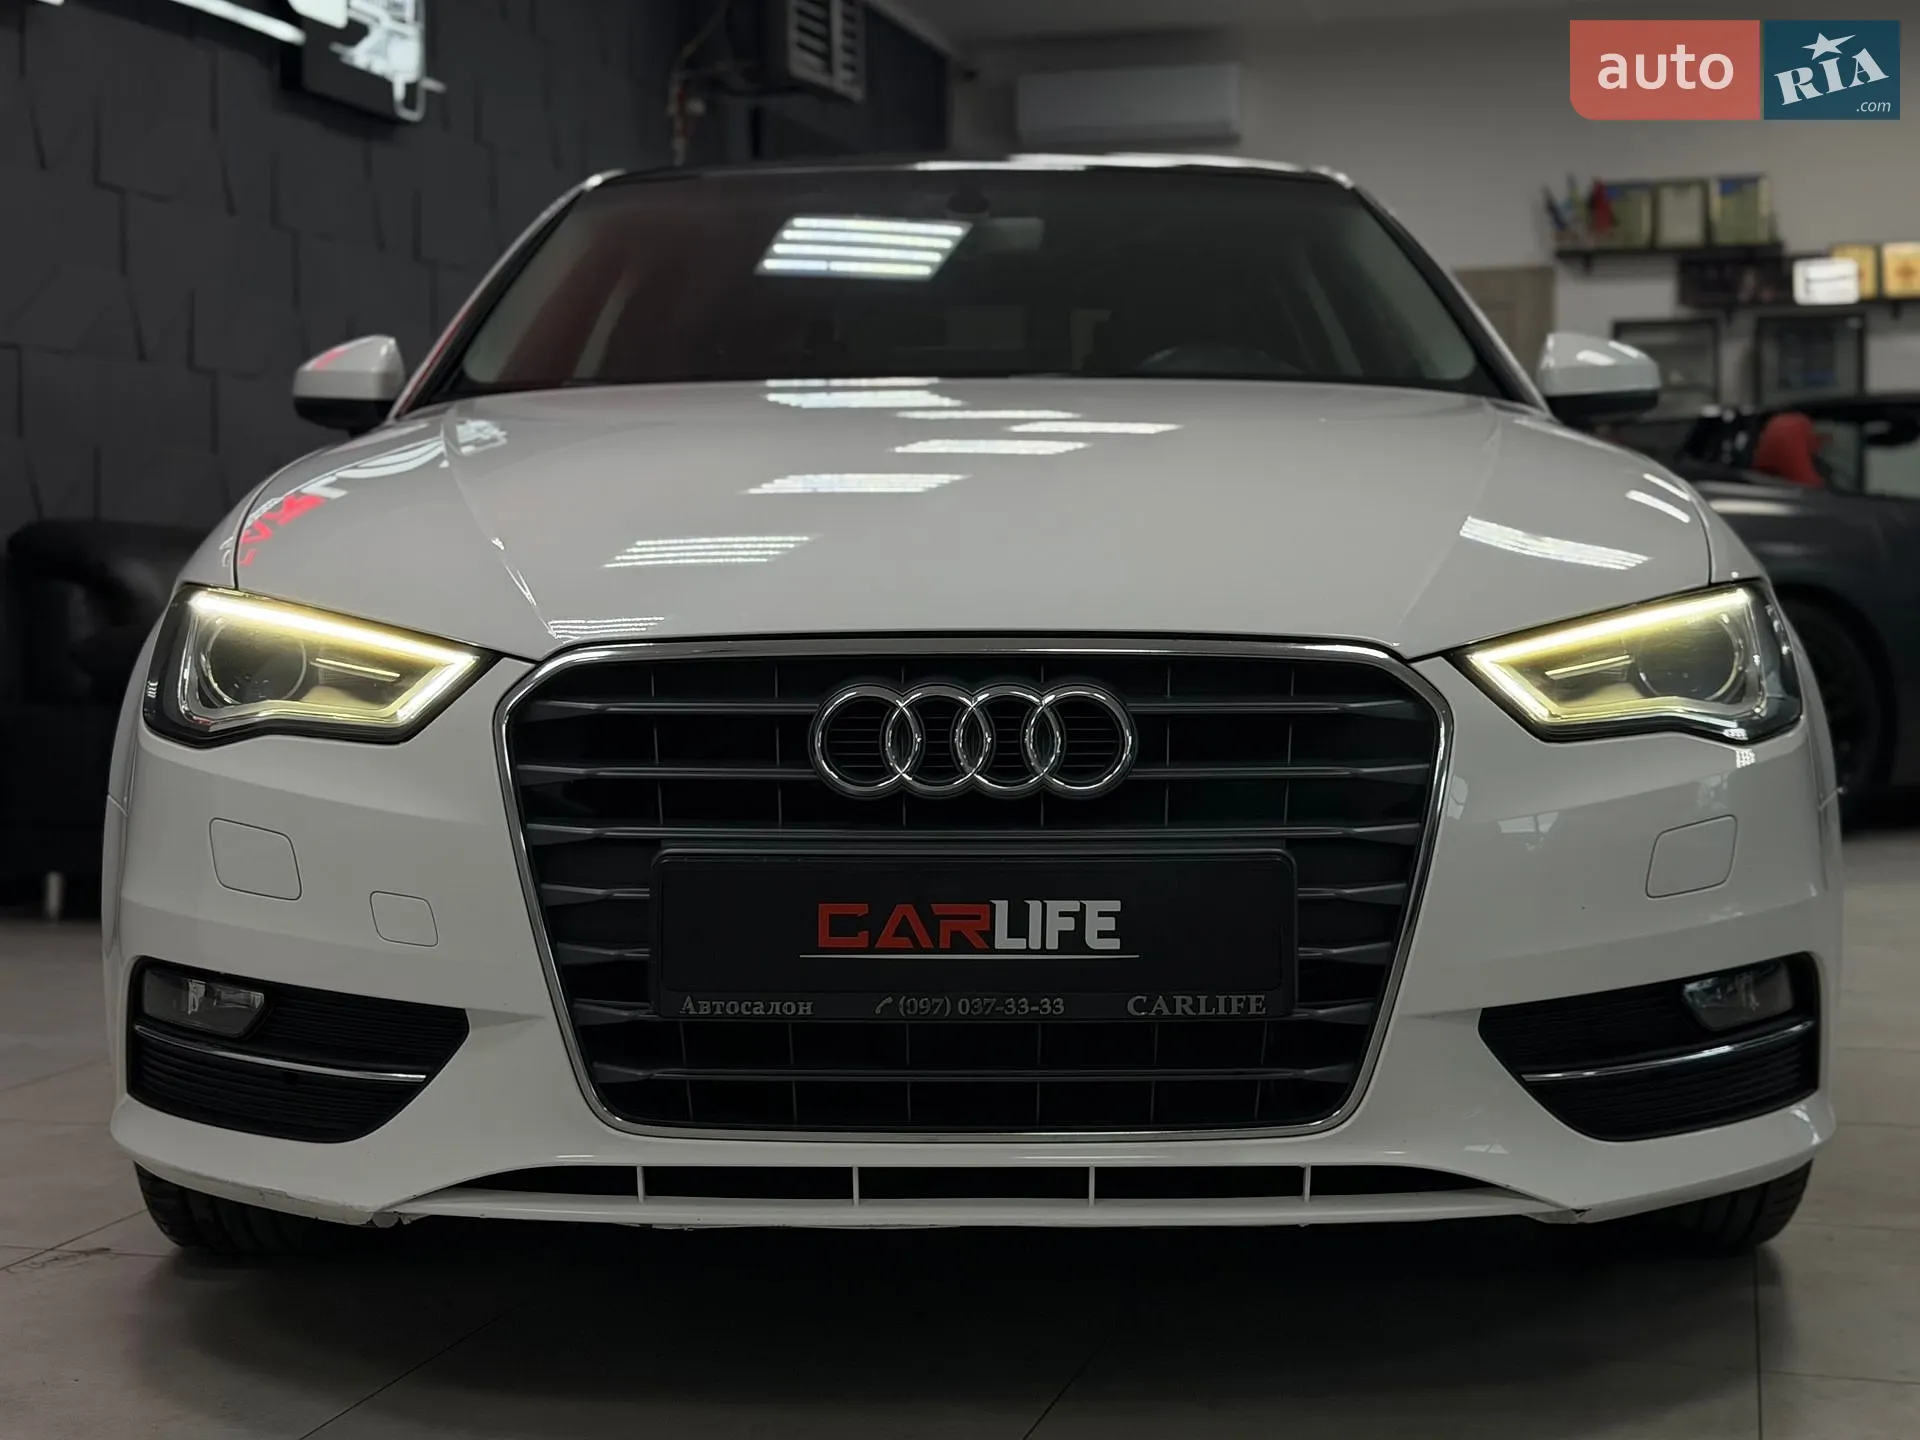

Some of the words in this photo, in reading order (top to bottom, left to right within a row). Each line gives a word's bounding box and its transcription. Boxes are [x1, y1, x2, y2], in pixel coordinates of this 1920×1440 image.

[818, 899, 1121, 950] CARLIFE
[679, 994, 815, 1016] Автосалон
[898, 995, 952, 1017] (097)
[957, 996, 1065, 1016] 037-33-33
[1127, 994, 1268, 1016] CARLIFE
